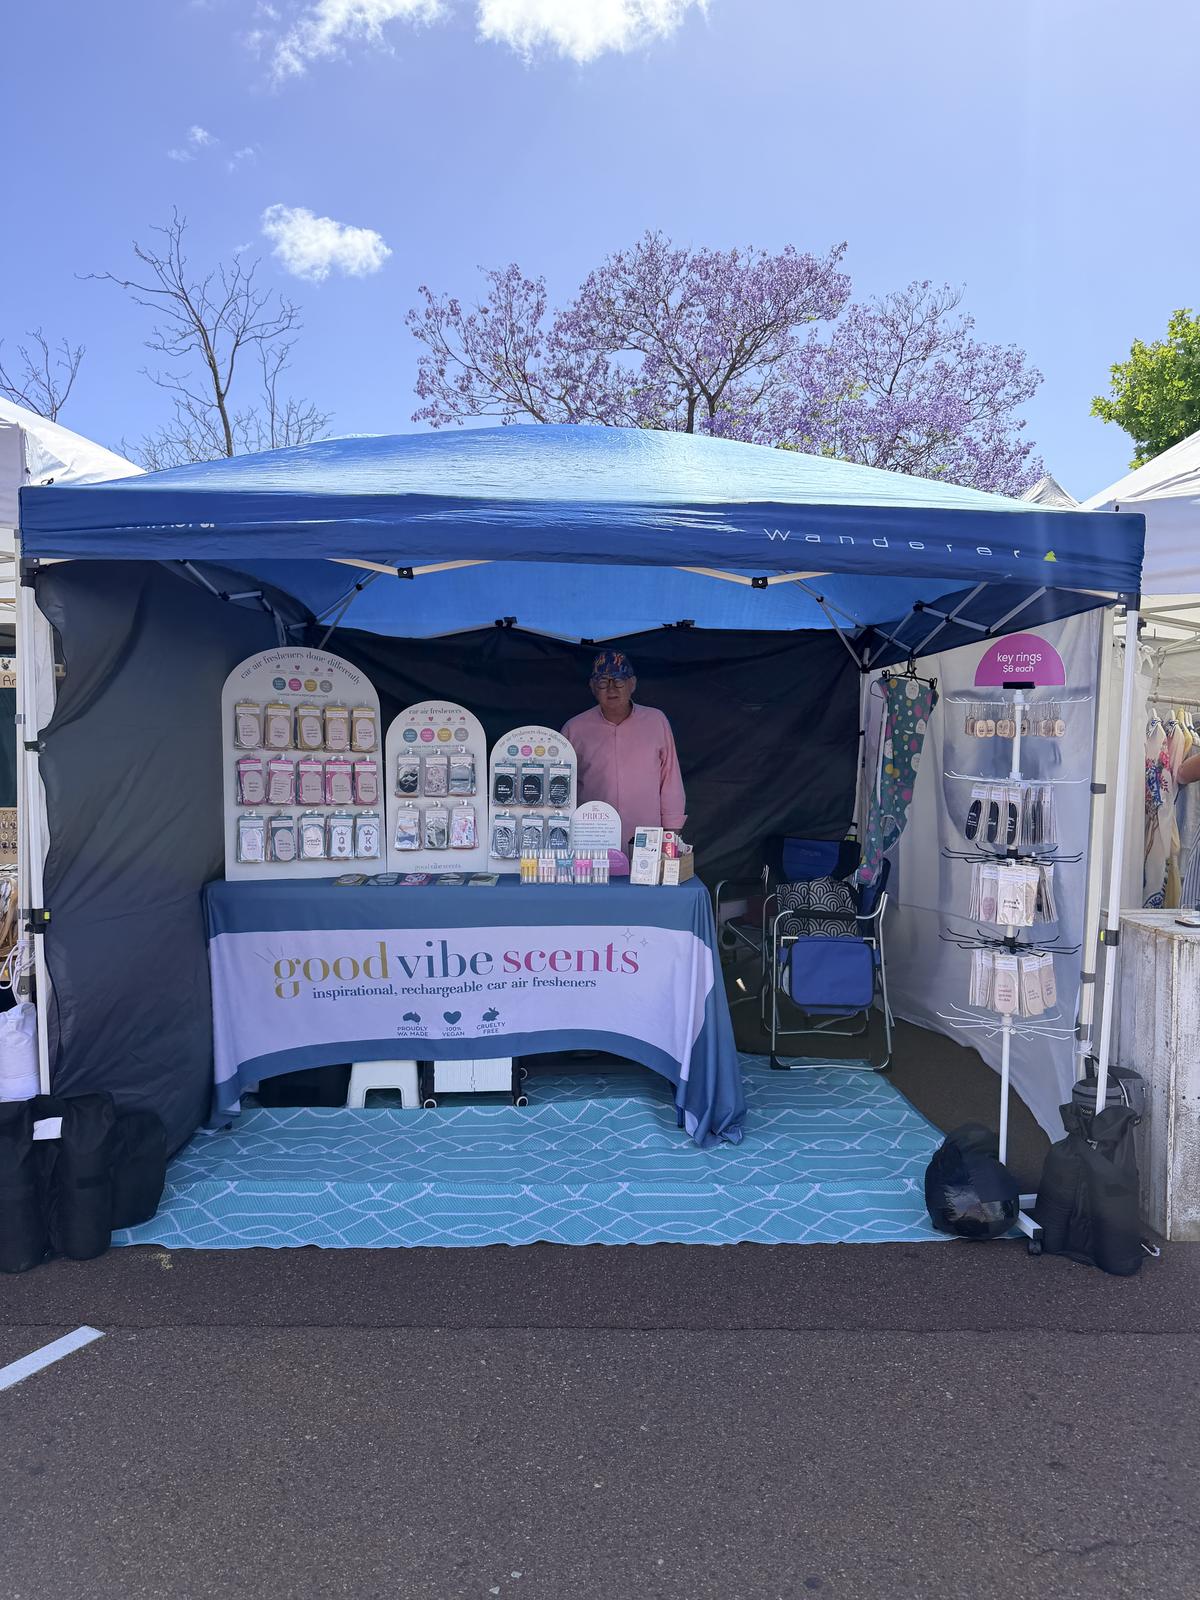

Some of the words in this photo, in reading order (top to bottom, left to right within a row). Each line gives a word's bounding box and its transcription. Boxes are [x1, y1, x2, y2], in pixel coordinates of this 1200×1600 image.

[762, 527, 1021, 559] Wanderer
[997, 652, 1014, 664] key
[1016, 652, 1042, 665] rings
[240, 668, 252, 680] car
[252, 660, 264, 672] air
[263, 651, 305, 665] fresheners
[306, 651, 326, 662] done
[327, 657, 361, 686] differently
[1003, 665, 1014, 673] $6
[1015, 664, 1034, 673] each
[582, 812, 610, 821] PRICES
[273, 942, 390, 1000] good
[396, 940, 493, 979] vibe
[503, 942, 640, 975] scents
[312, 982, 398, 1001] inspirational,
[401, 980, 483, 998] rechargeable
[487, 980, 507, 991] car
[510, 977, 529, 989] air
[532, 975, 597, 989] fresheners
[476, 1021, 506, 1030] CRUELTY
